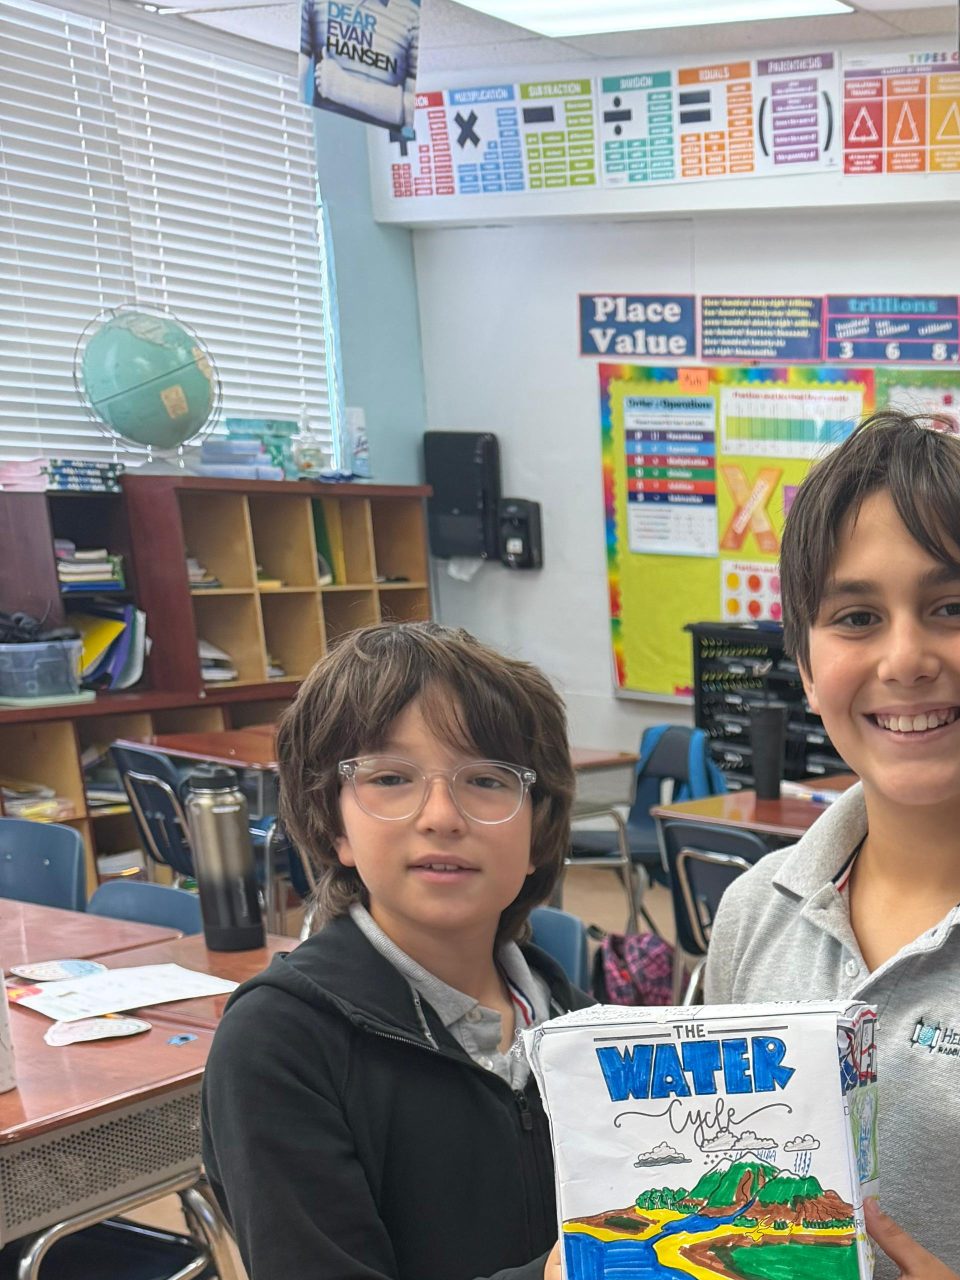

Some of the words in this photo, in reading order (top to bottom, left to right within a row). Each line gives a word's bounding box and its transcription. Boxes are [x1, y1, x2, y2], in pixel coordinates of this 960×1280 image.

[327, 1, 377, 31] DEAR
[327, 19, 373, 48] EVAN
[326, 35, 397, 74] HANSEN
[908, 52, 947, 64] TYPES
[592, 297, 682, 323] Place
[847, 298, 938, 313] trillions
[588, 328, 687, 354] Value
[839, 341, 854, 359] 3
[885, 342, 901, 360] 6
[672, 1024, 706, 1039] THE
[595, 1036, 797, 1102] WATER
